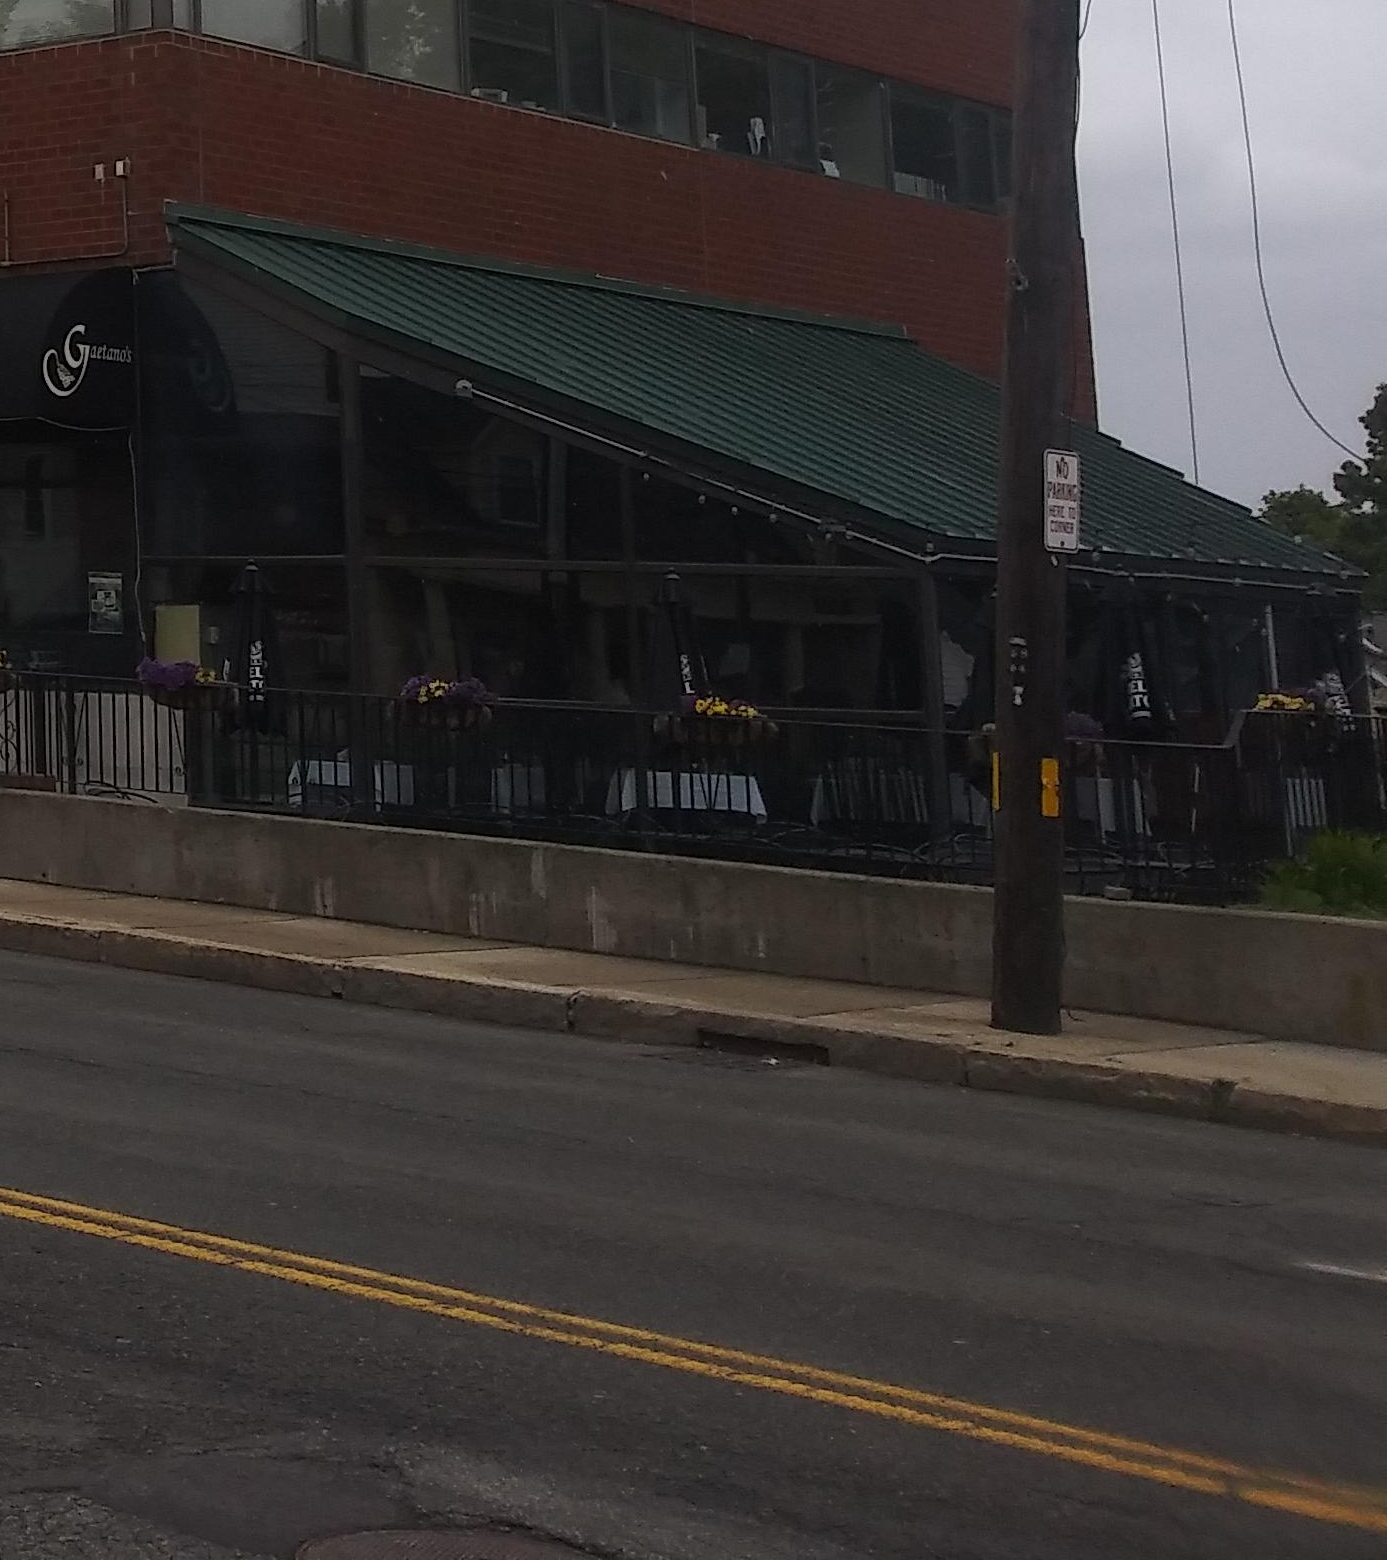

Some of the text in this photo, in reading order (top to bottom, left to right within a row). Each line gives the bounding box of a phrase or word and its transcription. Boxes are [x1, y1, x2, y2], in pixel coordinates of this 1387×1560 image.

[42, 323, 133, 398] Gaetano's
[1055, 459, 1069, 480] NO
[1047, 482, 1078, 502] PARKING
